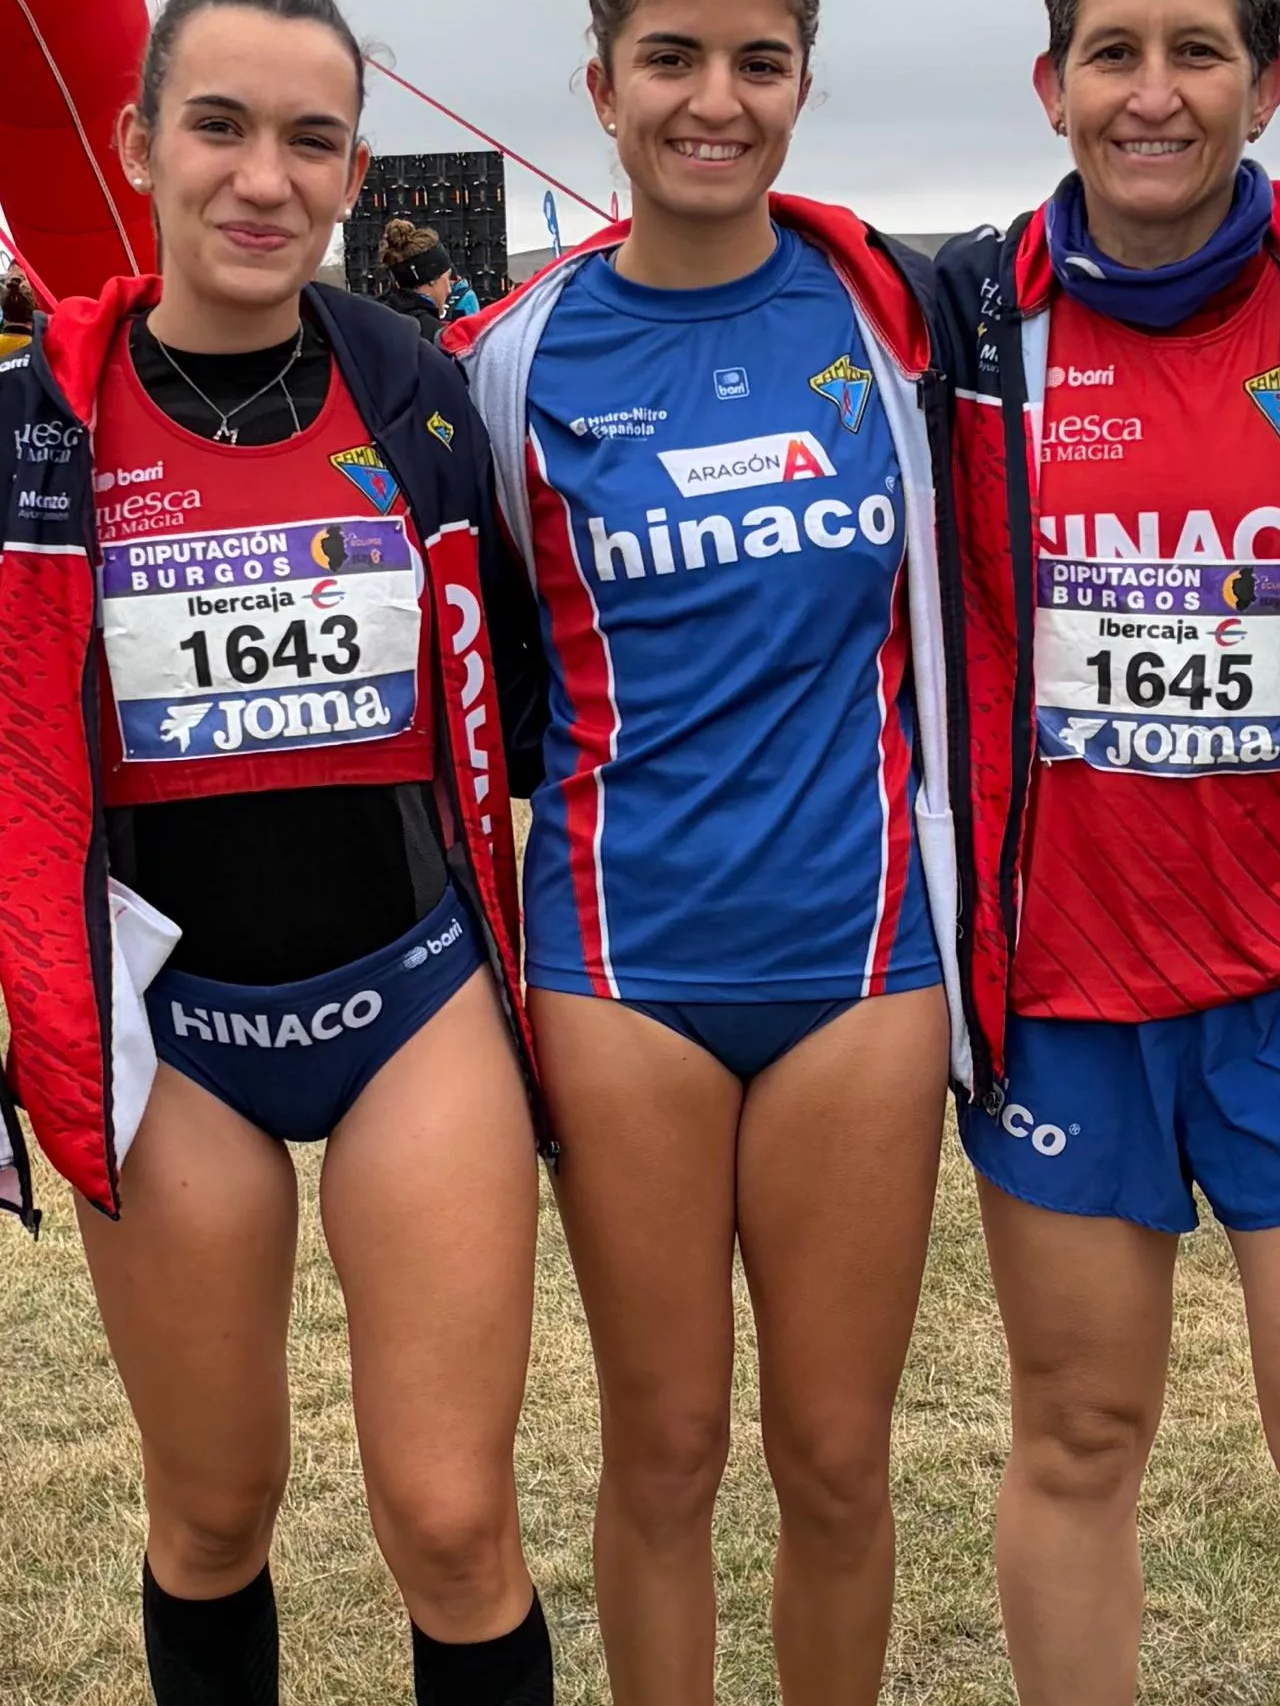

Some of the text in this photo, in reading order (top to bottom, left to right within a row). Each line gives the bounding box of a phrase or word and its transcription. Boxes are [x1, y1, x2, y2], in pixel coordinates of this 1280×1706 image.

[1068, 365, 1115, 387] barri
[587, 407, 667, 427] Hidro-Nitro
[592, 422, 655, 439] Española
[117, 461, 163, 486] barri
[686, 453, 781, 485] ARAGÓN
[129, 531, 288, 567] DIPUTACIÓN
[588, 494, 895, 582] hinaco
[132, 556, 291, 591] BURGOS
[1053, 563, 1201, 587] DIPUTACIÓN
[187, 587, 295, 618] Ibercaja
[1053, 586, 1201, 611] BURGOS
[1099, 618, 1199, 645] Ibercaja
[180, 615, 361, 688] 1643
[1086, 649, 1254, 712] 1645
[213, 685, 391, 750] Joma
[1106, 716, 1280, 765] Joma
[426, 917, 463, 954] barri
[171, 989, 383, 1048] HINACO
